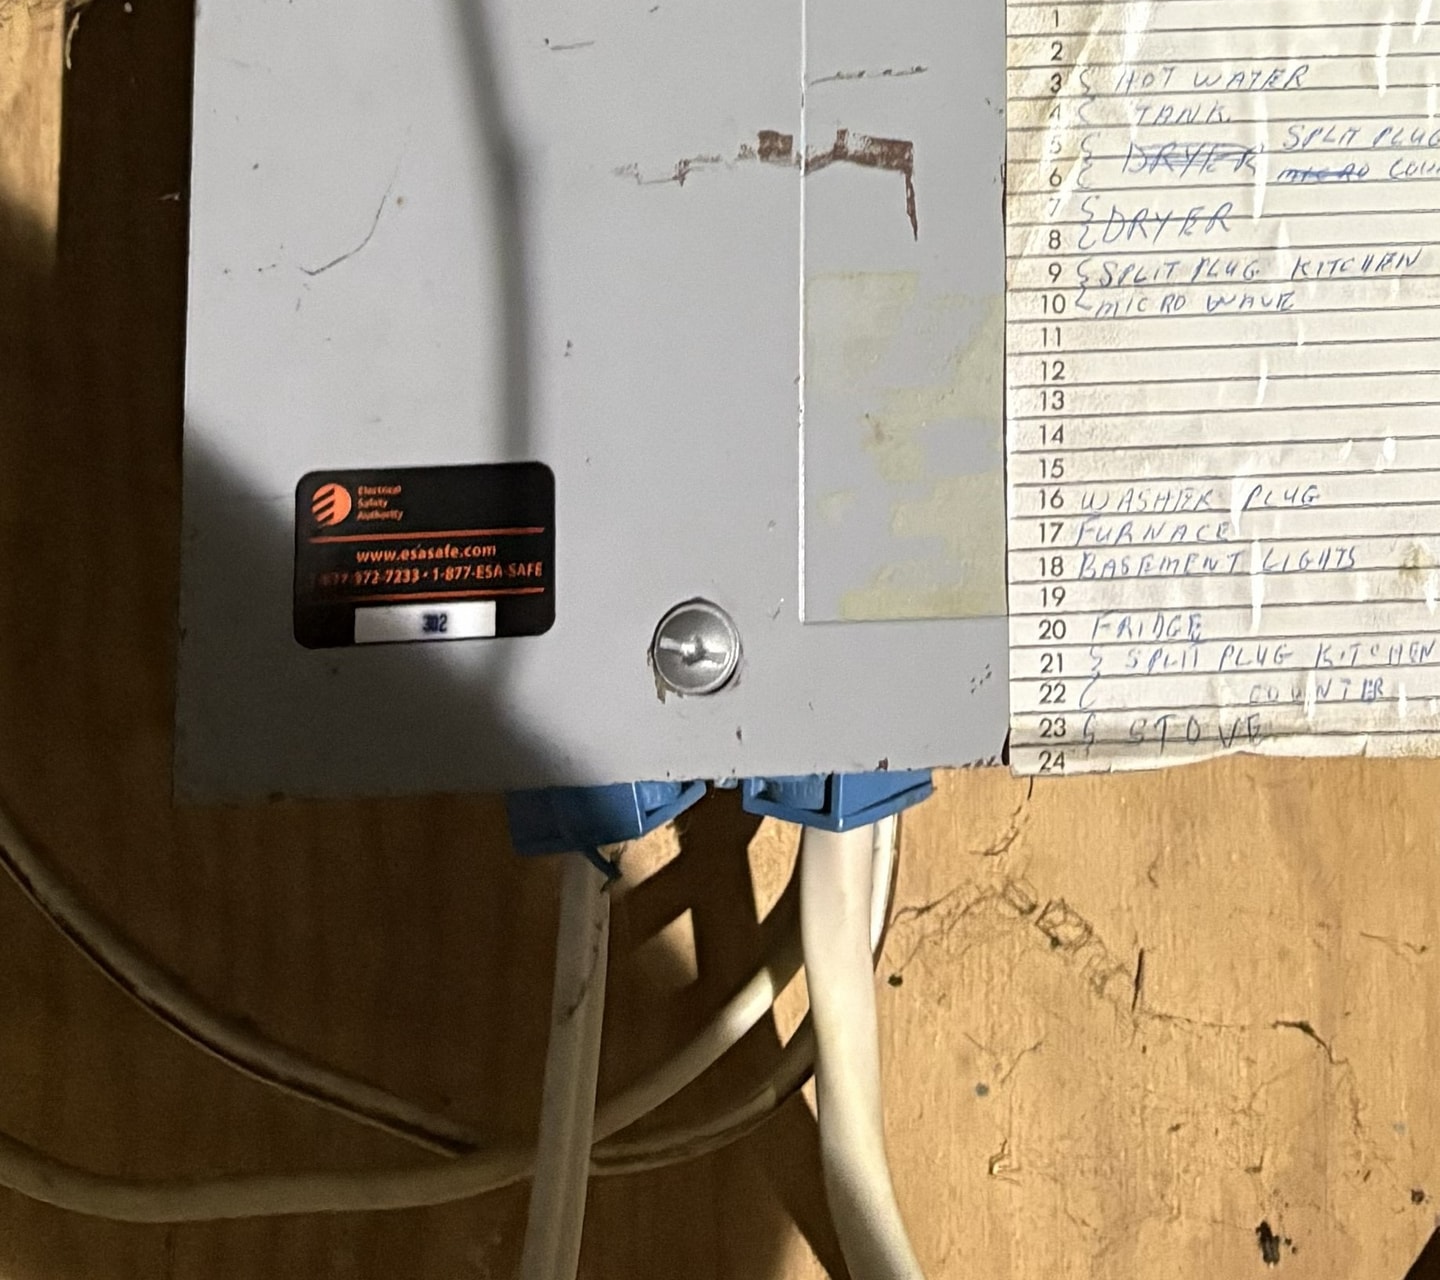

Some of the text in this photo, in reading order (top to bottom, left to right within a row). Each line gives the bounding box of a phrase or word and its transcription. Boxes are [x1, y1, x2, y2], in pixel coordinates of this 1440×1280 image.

[1053, 9, 1059, 28] 1
[1050, 41, 1063, 61] 2
[1050, 64, 1310, 94] 3 HOT WATER
[1050, 167, 1062, 187] 6
[1050, 198, 1061, 217] 7
[1049, 202, 1233, 250] 8 DRYER
[1048, 262, 1062, 283] 9
[1099, 260, 1181, 287] SPLIT
[1290, 247, 1424, 281] KITCHEN
[1041, 293, 1066, 314] 10
[1041, 326, 1062, 347] 11
[1041, 360, 1066, 382] 12
[1040, 390, 1065, 412] 13
[1039, 423, 1064, 446] 14
[1039, 457, 1065, 479] 15
[357, 484, 402, 496] Electrical
[1038, 484, 1321, 513] 16 WASHER PLUG
[357, 497, 389, 509] Safety
[356, 509, 405, 521] Authority
[1038, 514, 1232, 547] 17 FURNACE
[355, 542, 497, 563] www.esasafe.com
[1038, 544, 1357, 580] 18 BASEMENT LIGHTS
[1039, 586, 1066, 608] 19
[1038, 610, 1203, 642] 20 FRIDGE
[1039, 652, 1064, 674] 21
[1219, 643, 1294, 672] PLUG
[1315, 638, 1438, 670] KITCHEN
[1039, 684, 1067, 705] 22
[1039, 712, 1266, 755] 23 STOVE
[1038, 750, 1066, 773] 24
